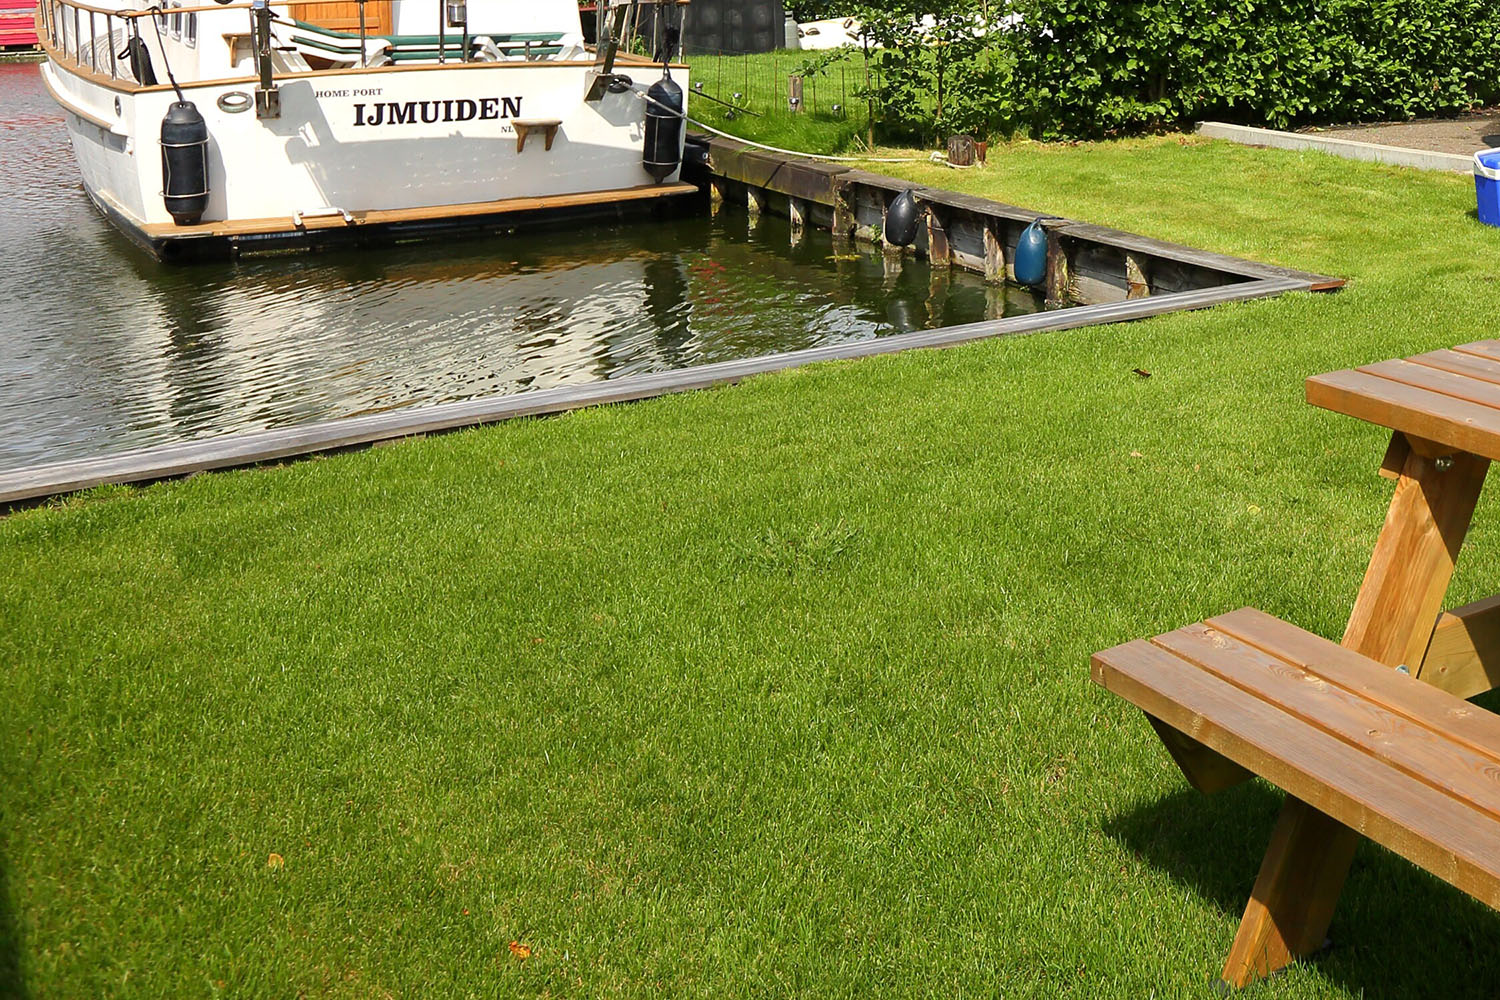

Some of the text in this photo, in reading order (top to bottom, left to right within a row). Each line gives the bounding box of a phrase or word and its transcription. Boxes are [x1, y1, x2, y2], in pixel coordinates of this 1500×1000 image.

[315, 88, 383, 99] HOME PORT
[353, 96, 523, 126] IJMUIDEN
[500, 125, 515, 134] NL
